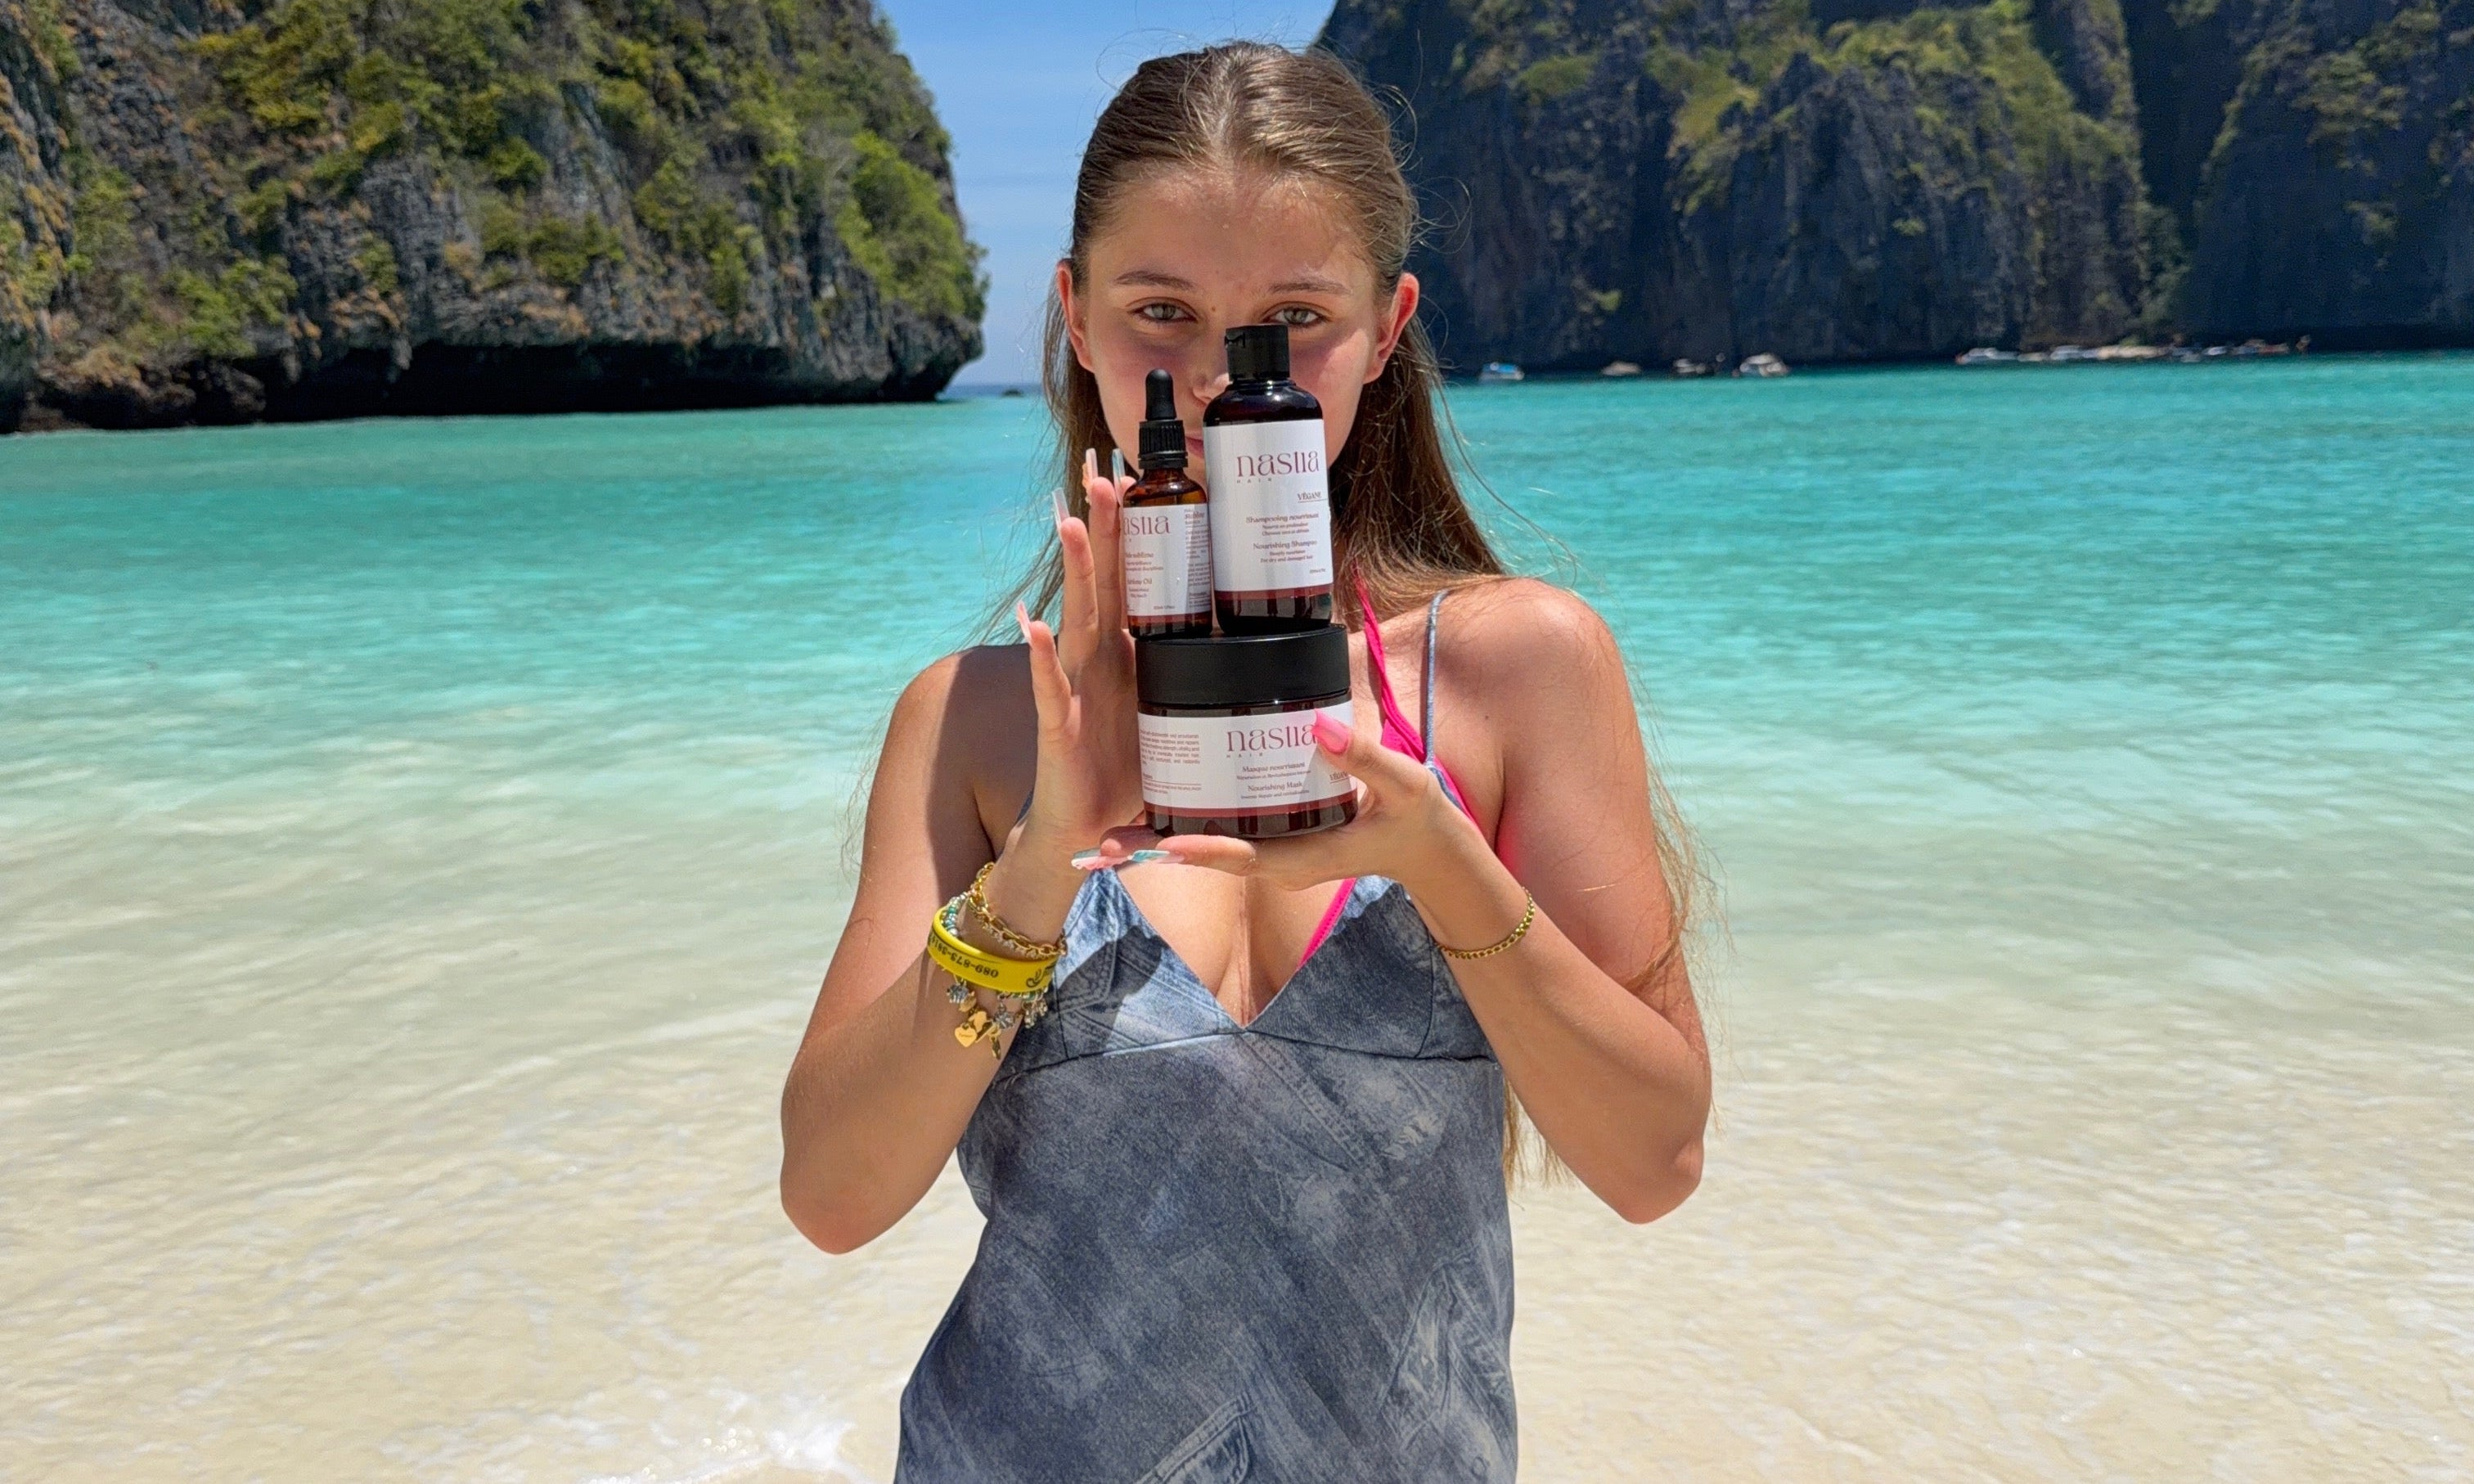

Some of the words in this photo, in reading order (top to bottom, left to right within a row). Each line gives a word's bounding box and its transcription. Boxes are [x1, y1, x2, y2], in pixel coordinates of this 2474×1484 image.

[1253, 542, 1290, 550] Nourishing
[1248, 782, 1285, 792] Nourishing
[1286, 780, 1303, 789] Mask
